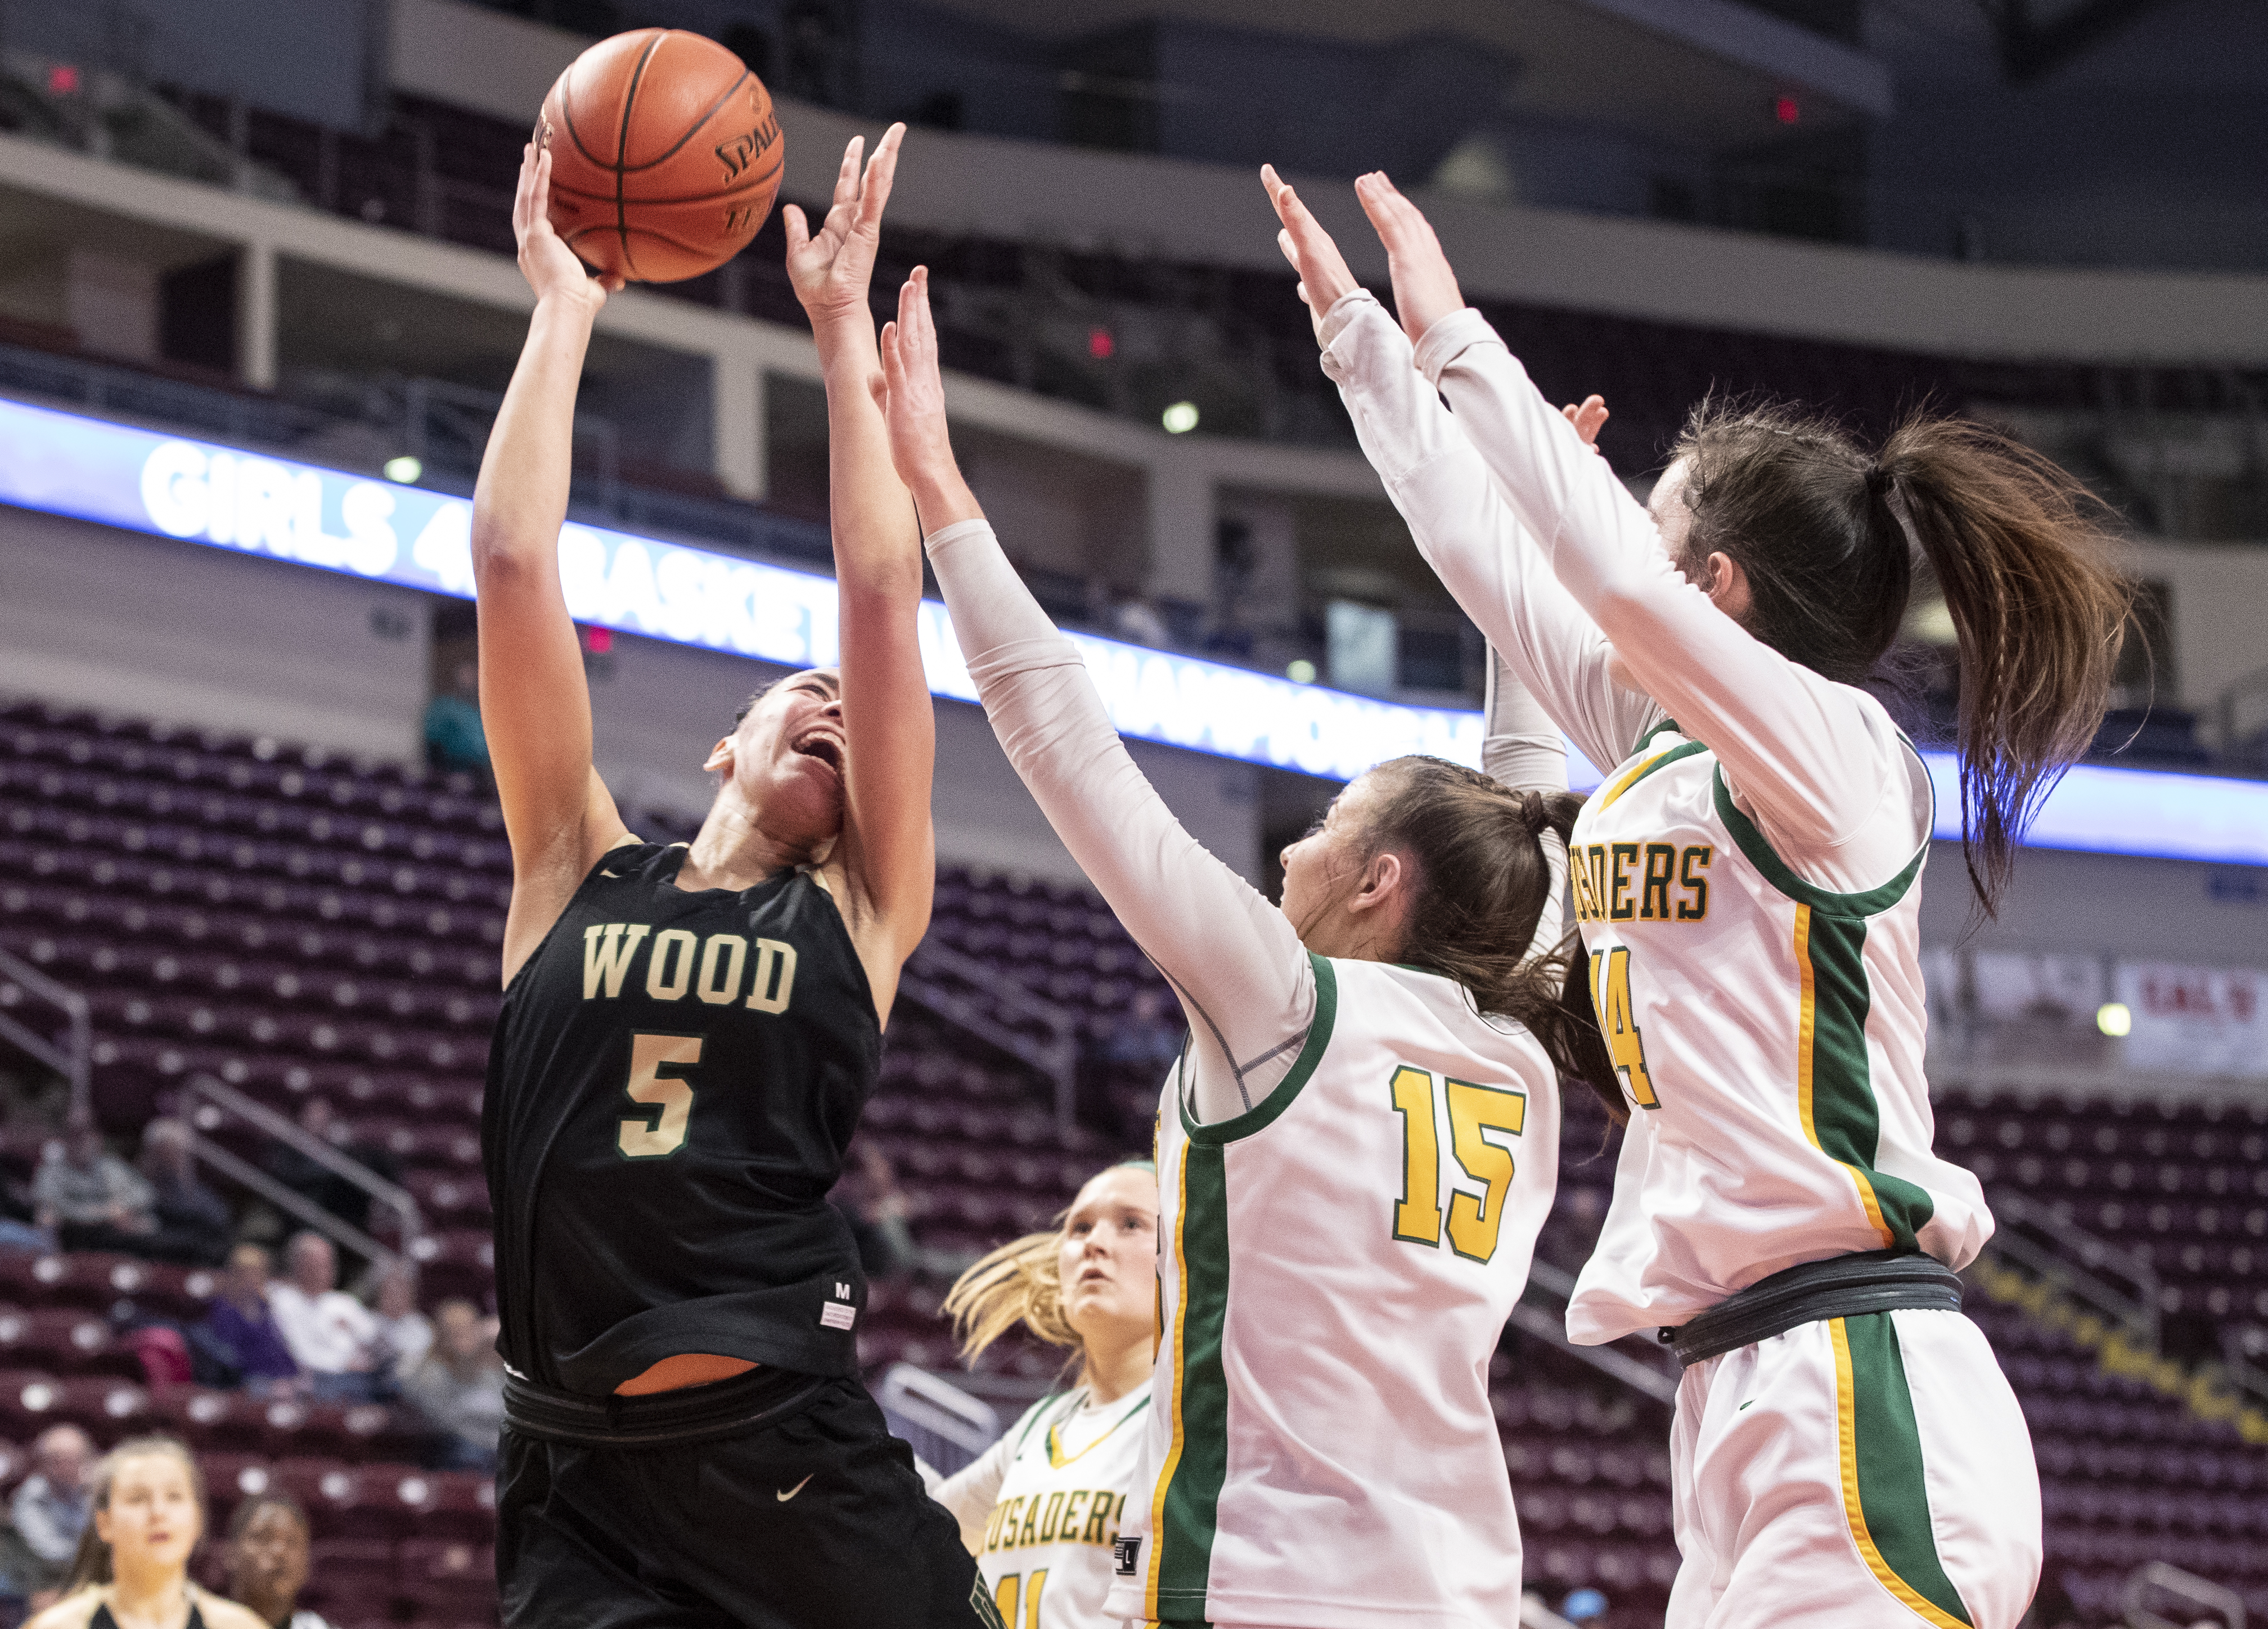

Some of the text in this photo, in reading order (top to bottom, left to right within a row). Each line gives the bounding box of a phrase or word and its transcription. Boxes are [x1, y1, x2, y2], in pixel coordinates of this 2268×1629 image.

[141, 441, 398, 576] GIRLS
[412, 501, 478, 597] 4
[583, 922, 798, 1015] WOOD
[618, 1033, 704, 1158] 5
[1389, 1064, 1527, 1266] 15
[835, 1282, 850, 1300] M
